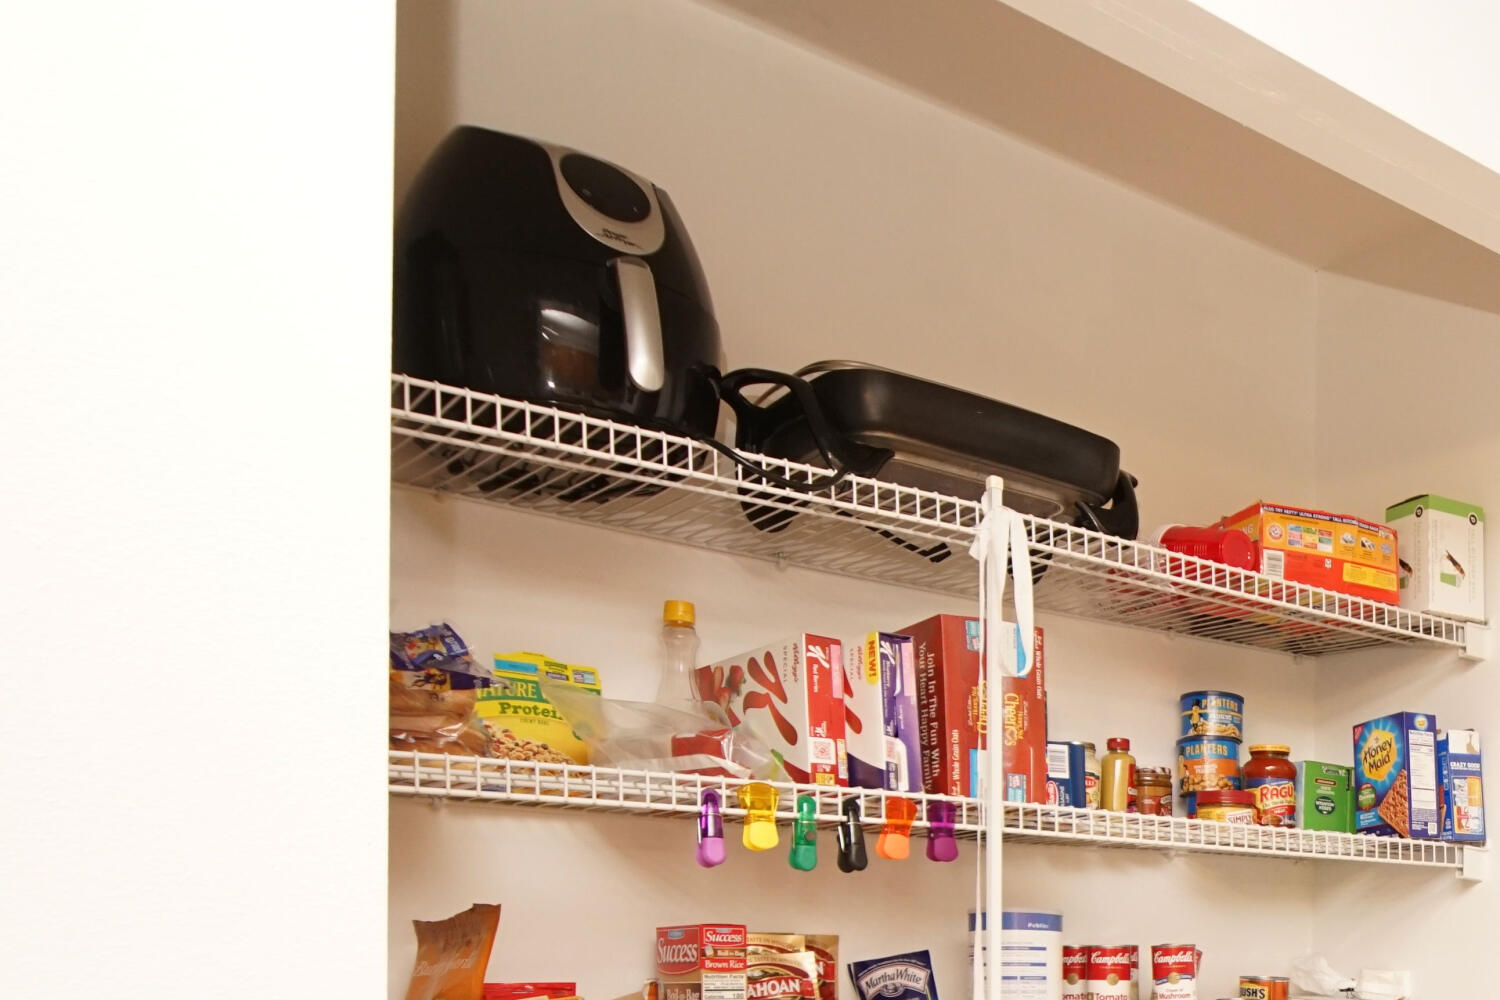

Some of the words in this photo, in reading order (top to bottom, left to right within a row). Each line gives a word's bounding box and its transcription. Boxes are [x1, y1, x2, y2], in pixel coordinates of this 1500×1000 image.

[868, 640, 877, 678] NEW!
[918, 642, 927, 668] Your
[926, 652, 936, 677] Join
[919, 671, 928, 706] Heart
[928, 680, 937, 694] In
[929, 695, 938, 719] The
[920, 709, 930, 747] Happy
[930, 721, 939, 746] Fun
[952, 744, 960, 762] Grain
[1185, 743, 1228, 756] PLANTERS
[1362, 737, 1393, 765] Honey
[931, 748, 940, 778] With
[952, 762, 960, 781] Whole
[1368, 752, 1391, 774] Maid
[705, 930, 742, 943] Success
[657, 937, 698, 964] Success
[705, 960, 729, 969] Brown
[729, 960, 744, 969] Rice
[747, 978, 801, 998] AHOAN
[866, 971, 895, 990] Martha
[896, 968, 922, 985] White
[1095, 992, 1128, 1000] Tomato
[1240, 987, 1266, 999] USH'S
